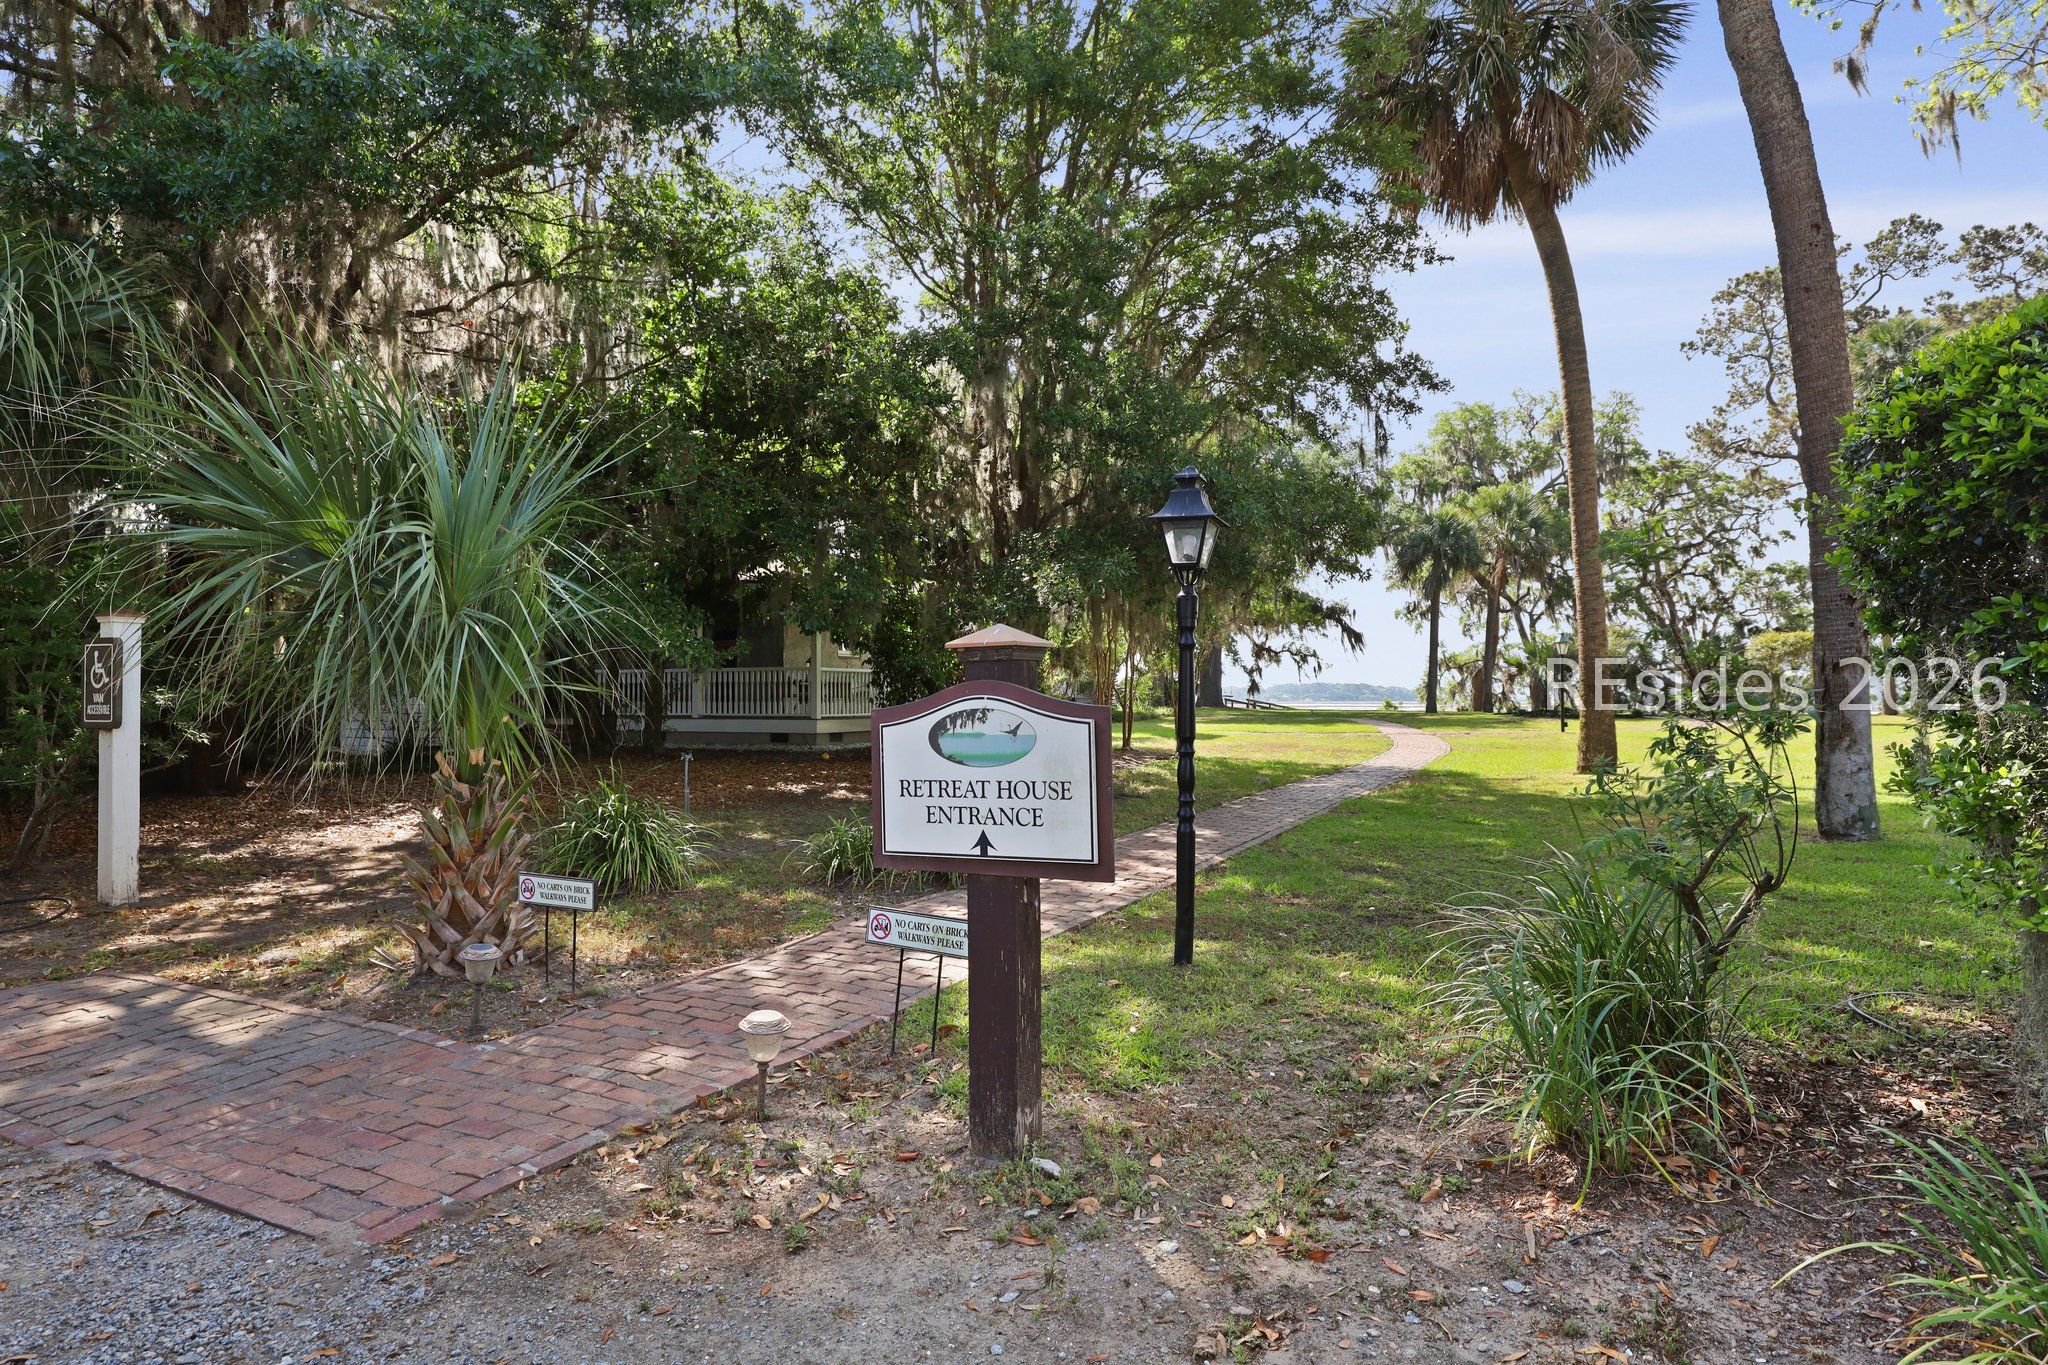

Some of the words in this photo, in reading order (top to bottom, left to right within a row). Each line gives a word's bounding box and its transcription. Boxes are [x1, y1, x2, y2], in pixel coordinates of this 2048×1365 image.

[92, 692, 104, 703] VAN
[87, 704, 110, 715] ACCESSIBLE
[899, 779, 990, 799] RETREAT
[996, 780, 1073, 801] HOUSE
[926, 805, 1044, 827] ENTRANCE
[547, 883, 563, 892] CARTS
[564, 884, 572, 893] ON
[573, 886, 591, 895] BRICK
[540, 892, 567, 902] WALKWAYS
[568, 895, 587, 905] PLEASE
[894, 918, 906, 929] NO
[908, 920, 931, 933] CARTS
[932, 924, 944, 935] ON
[897, 931, 935, 945] WALKWAYS
[937, 937, 965, 951] PLEASE
